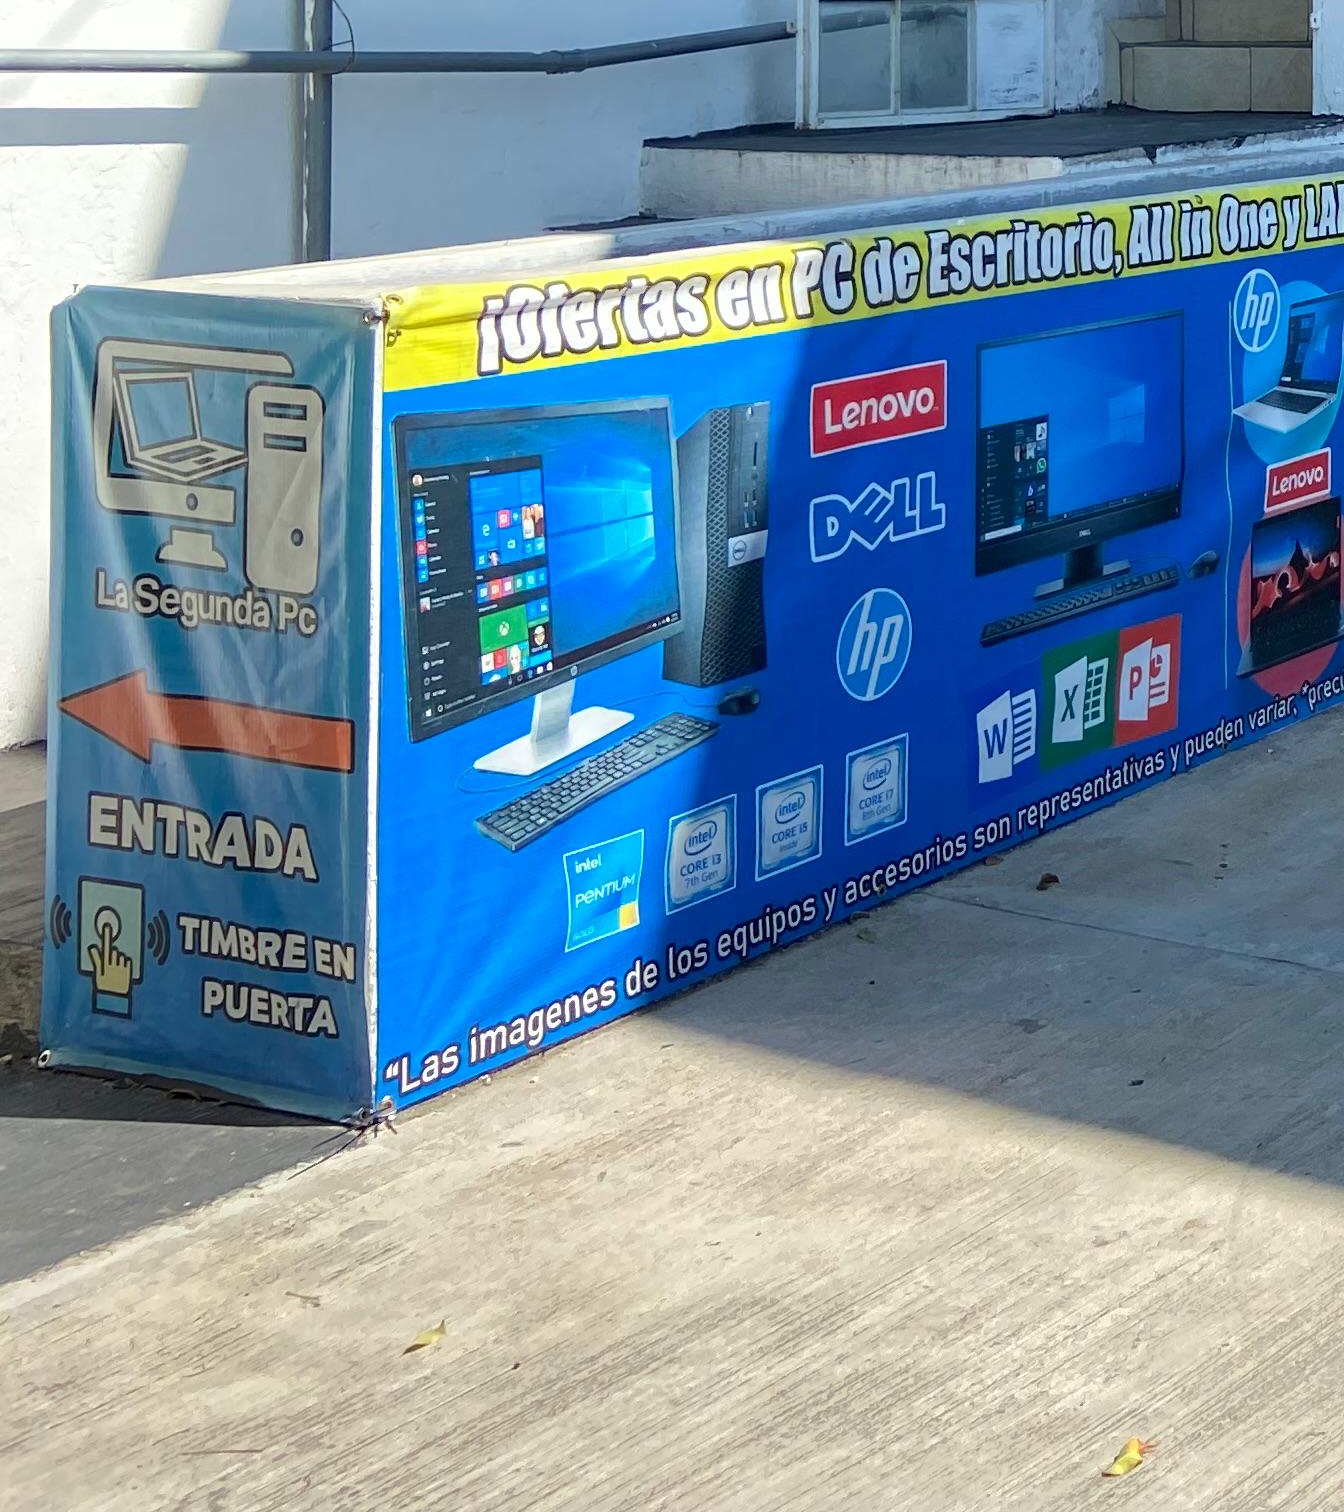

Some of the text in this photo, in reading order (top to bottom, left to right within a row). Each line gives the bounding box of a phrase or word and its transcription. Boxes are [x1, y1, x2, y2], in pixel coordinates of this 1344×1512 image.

[476, 271, 711, 377] ¡Ofertas
[716, 261, 786, 330] en
[790, 238, 855, 318] PC
[863, 230, 923, 307] de
[925, 214, 1124, 297] Escritorio,
[1128, 202, 1174, 269] All
[1178, 197, 1213, 259] in
[1219, 194, 1279, 256] One
[1283, 195, 1301, 250] y
[1238, 269, 1277, 351] hp
[823, 386, 936, 435] Lenovo
[1270, 463, 1326, 497] Lenovo
[809, 471, 947, 563] DELL
[95, 569, 318, 636] La Segunda Pc
[845, 589, 907, 701] hp
[87, 793, 318, 882] ENTRADA
[574, 853, 603, 875] intel
[680, 860, 708, 877] CORE
[688, 831, 713, 845] intel
[469, 979, 617, 1065] imagenes
[624, 958, 658, 998] de
[668, 939, 708, 981] los
[717, 895, 817, 960] equipos
[823, 889, 838, 921] y
[844, 830, 968, 906] accesorios
[974, 813, 1011, 849] son
[1017, 744, 1165, 833] representativas
[1170, 744, 1180, 773] y
[1184, 716, 1245, 766] pueden
[1248, 695, 1298, 731] variar,
[685, 870, 718, 887] 7th Gen
[177, 913, 357, 982] TIMBRE EN
[201, 977, 340, 1035] PUERTA
